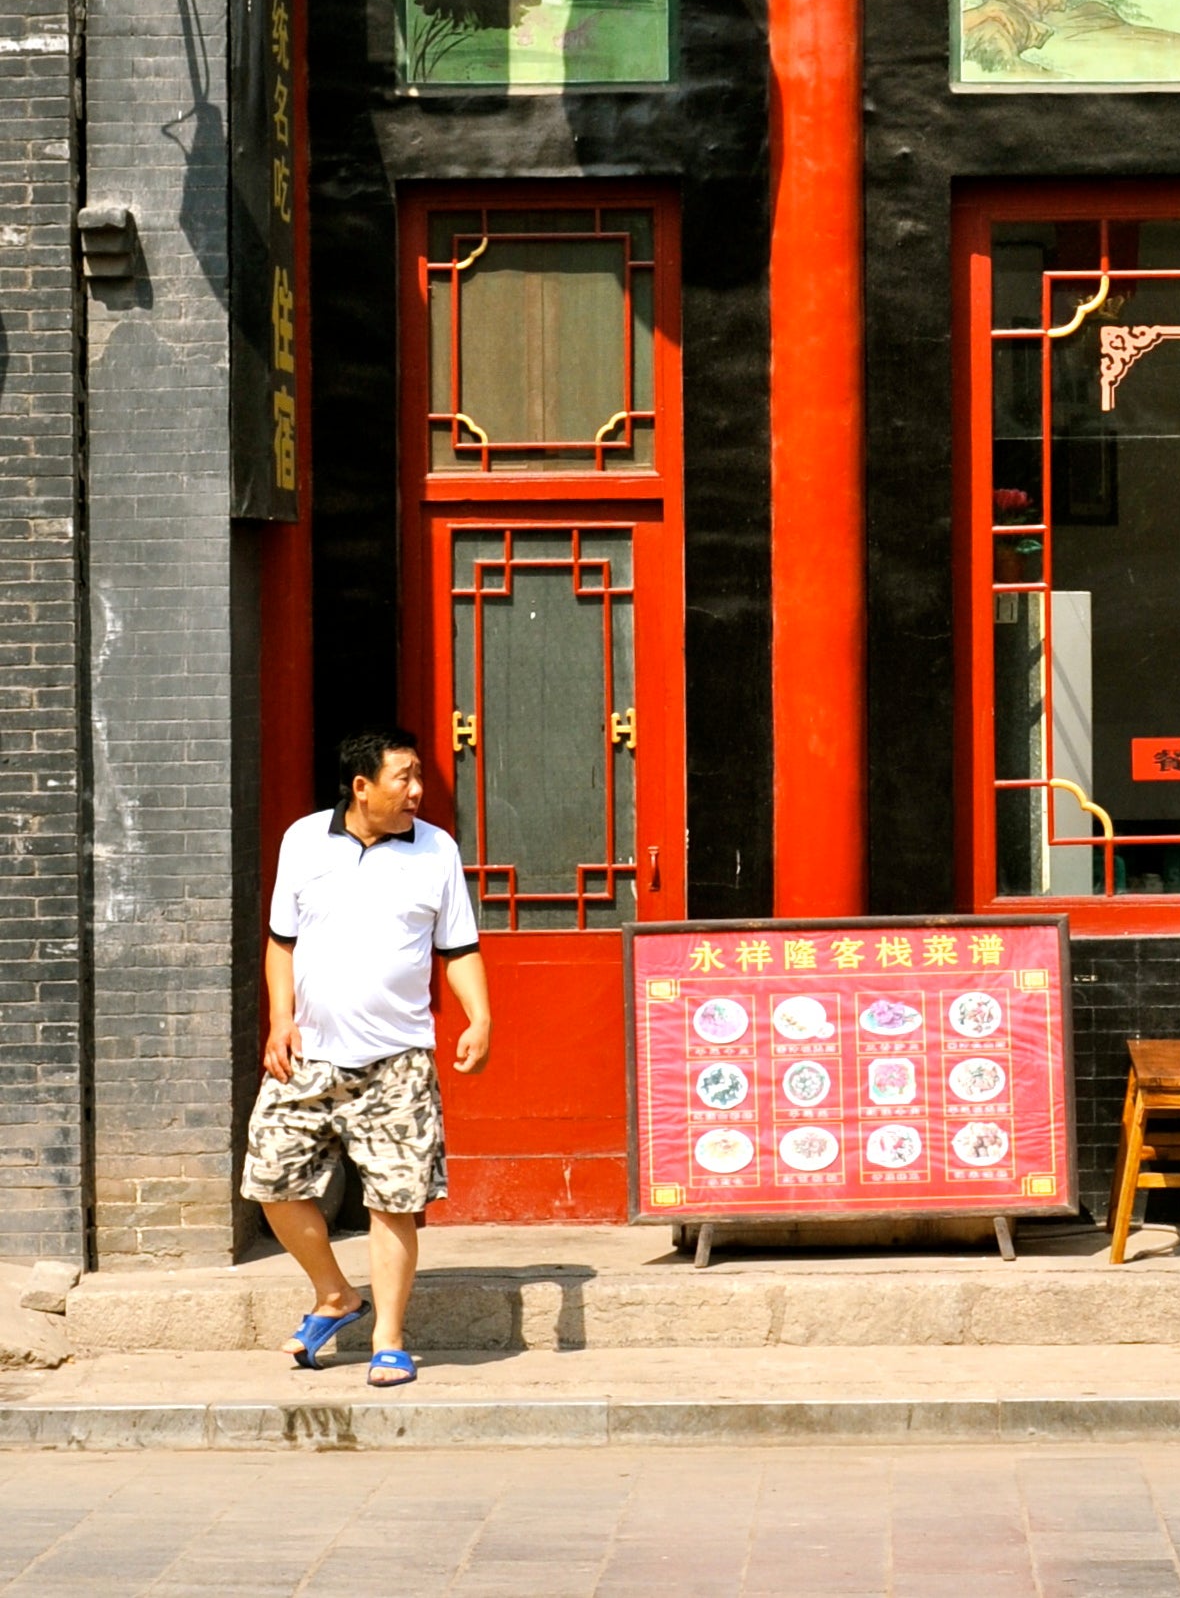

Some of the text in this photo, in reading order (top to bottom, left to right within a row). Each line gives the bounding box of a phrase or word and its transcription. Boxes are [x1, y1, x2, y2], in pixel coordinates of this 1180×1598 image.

[271, 265, 295, 491] 住宿
[689, 934, 1005, 973] 永祥隆客栈菜谱
